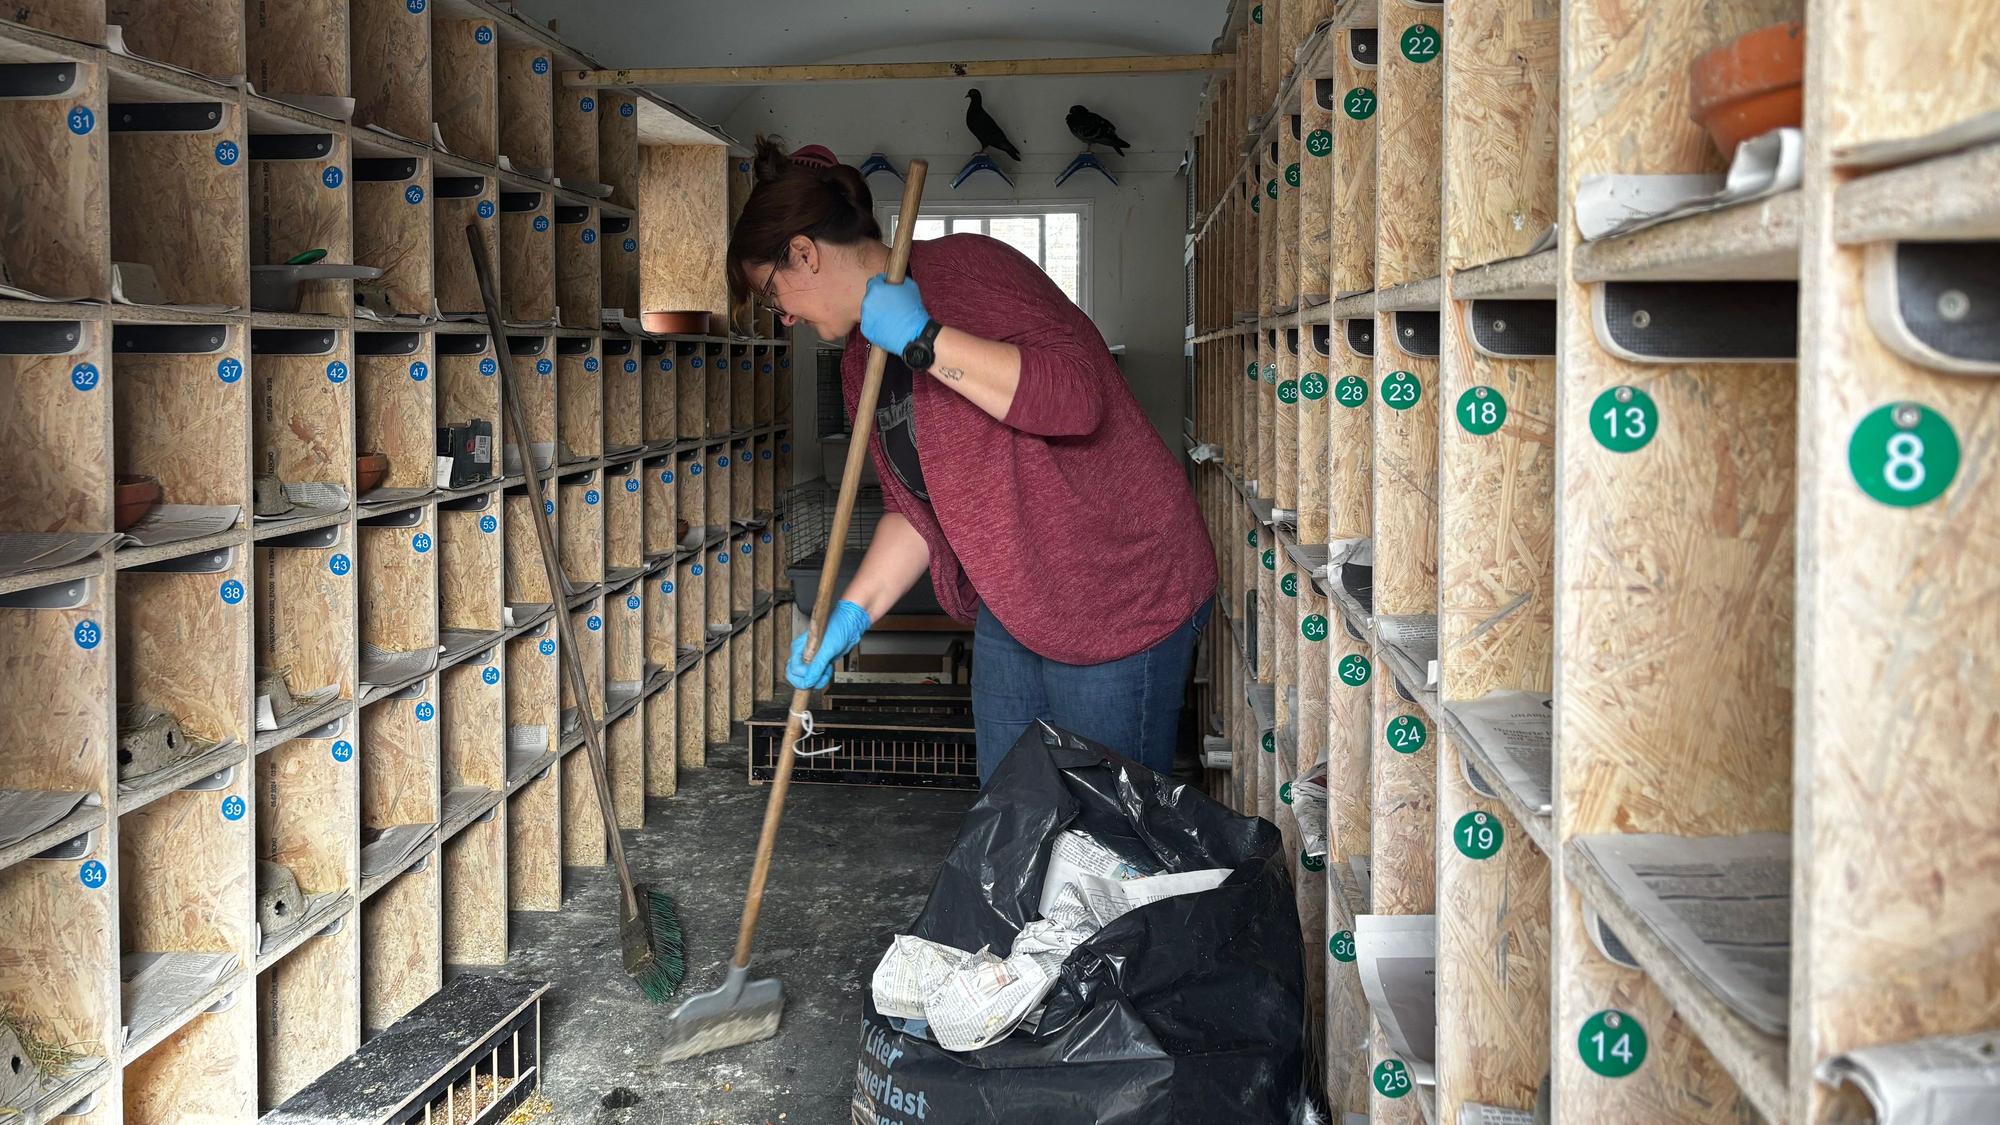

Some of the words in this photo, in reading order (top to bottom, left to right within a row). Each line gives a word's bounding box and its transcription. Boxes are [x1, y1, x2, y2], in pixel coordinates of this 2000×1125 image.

[409, 0, 423, 9] 45
[1409, 38, 1434, 55] 22
[1350, 99, 1372, 113] 27
[73, 116, 90, 129] 31
[1311, 139, 1330, 152] 32
[219, 149, 235, 160] 36
[326, 174, 339, 184] 41
[408, 191, 421, 202] 46
[222, 366, 239, 378] 37
[330, 368, 344, 378] 42
[413, 368, 425, 377] 47
[482, 364, 494, 373] 52
[539, 364, 551, 372] 57
[75, 372, 94, 385] 32
[1282, 388, 1298, 399] 38
[1305, 382, 1323, 394] 33
[1341, 386, 1363, 401] 28
[1389, 384, 1415, 401] 23
[1466, 402, 1497, 424] 18
[1604, 407, 1646, 438] 13
[1884, 436, 1925, 490] 8
[483, 521, 495, 530] 53
[415, 539, 429, 548] 48
[333, 561, 347, 571] 43
[224, 587, 240, 599] 38
[1307, 623, 1325, 636] 34
[79, 630, 97, 643] 33
[485, 672, 497, 681] 54
[1343, 664, 1366, 681] 29
[418, 708, 432, 717] 49
[1394, 727, 1421, 747] 24
[335, 747, 349, 758] 44
[225, 804, 242, 816] 39
[1464, 826, 1493, 850] 19
[85, 869, 102, 882] 34
[1336, 940, 1356, 955] 30
[865, 1025, 903, 1069] Liter
[1591, 1032, 1633, 1063] 14
[1381, 1071, 1408, 1092] 25
[861, 1064, 925, 1120] verlast
